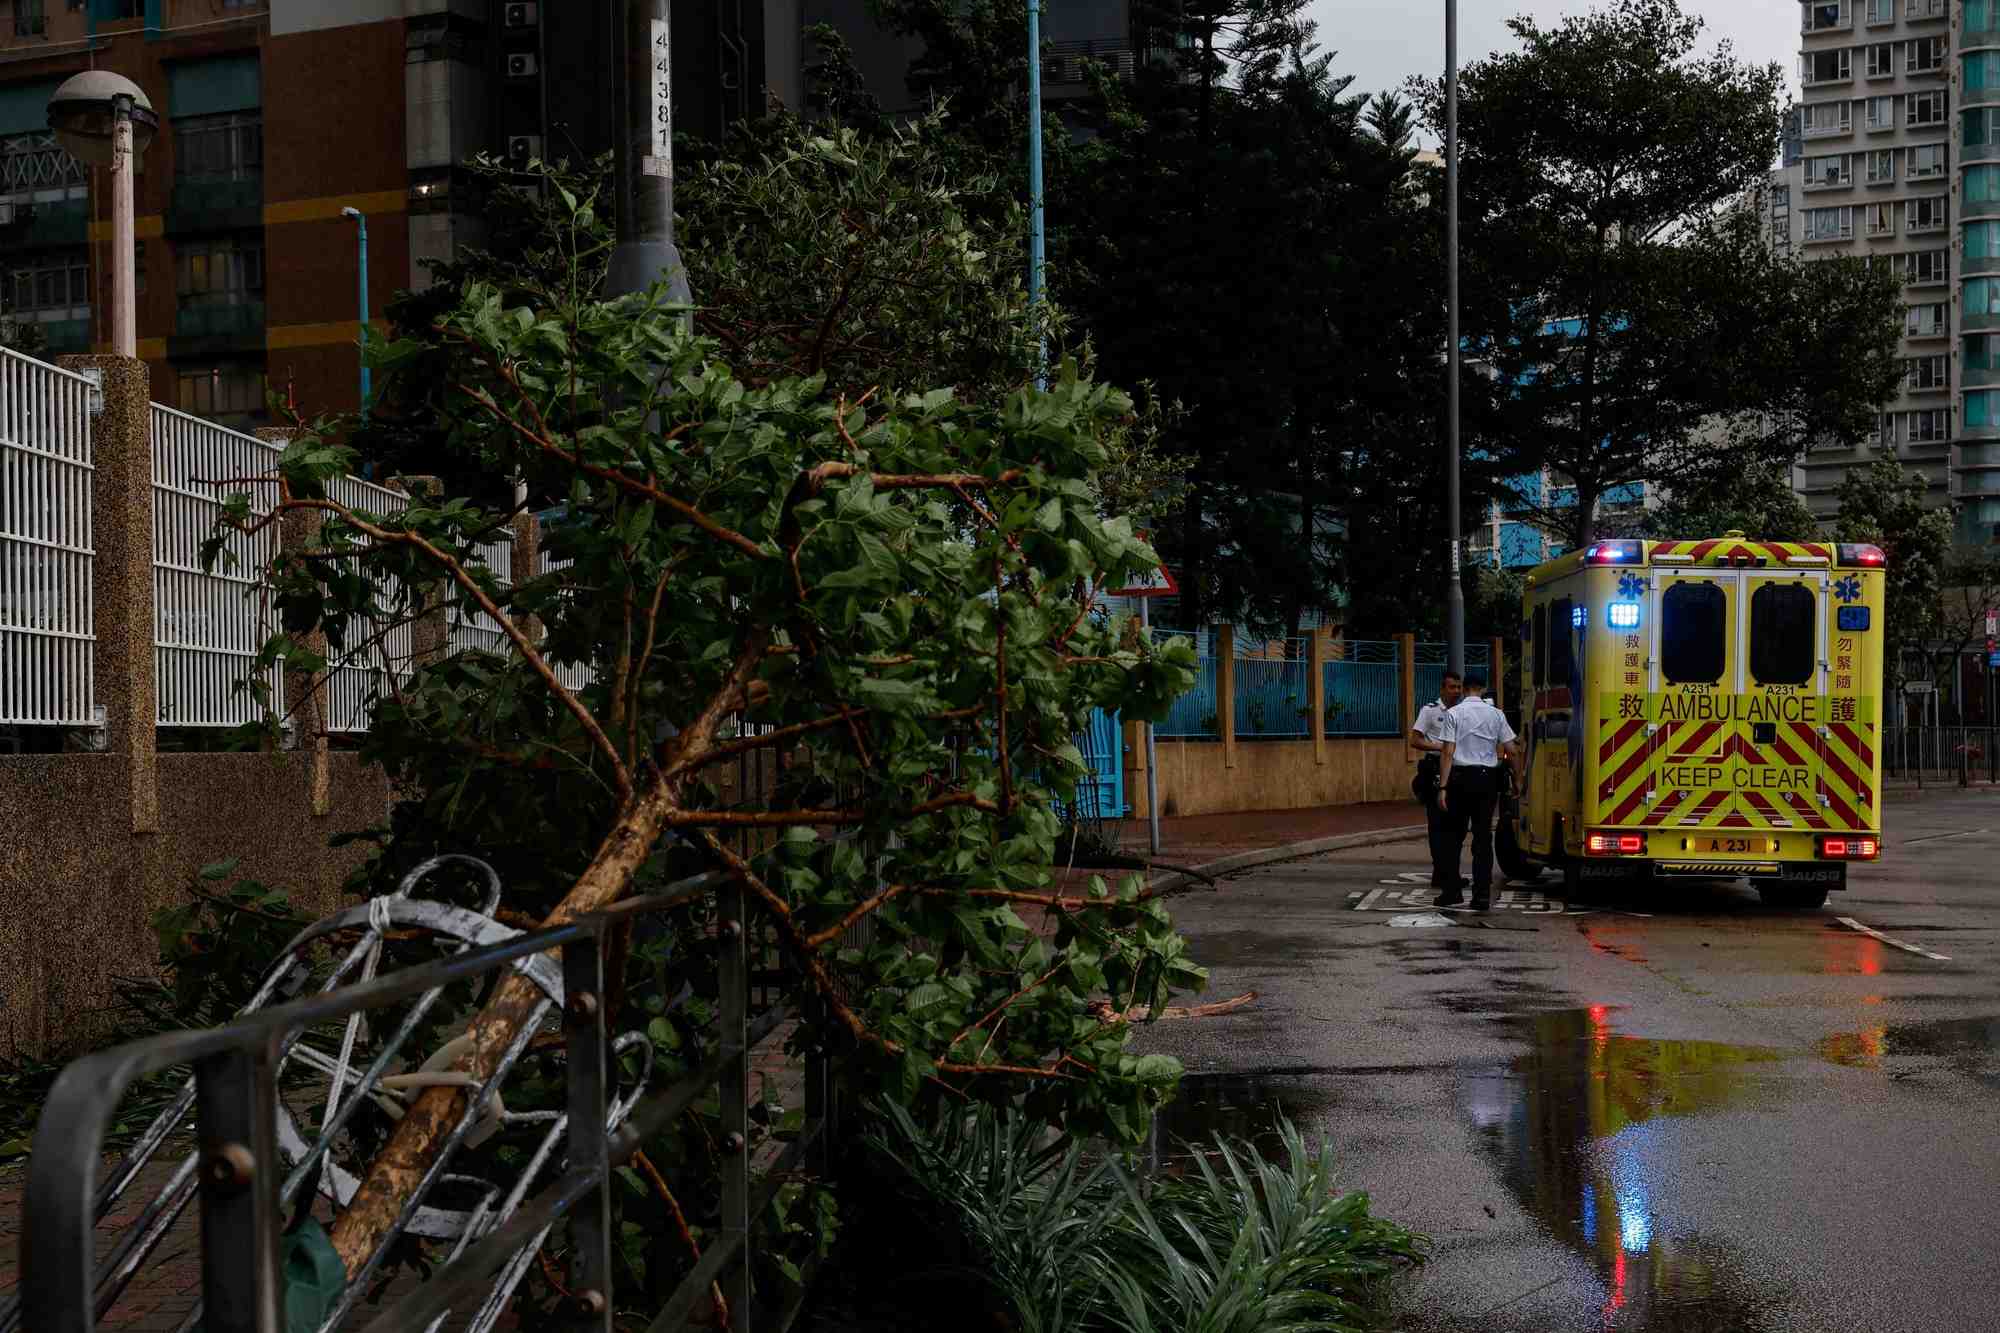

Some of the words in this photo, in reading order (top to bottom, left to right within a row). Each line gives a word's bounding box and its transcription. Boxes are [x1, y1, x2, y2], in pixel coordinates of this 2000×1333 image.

[655, 31, 669, 147] 44381
[1624, 633, 1640, 687] 救護車
[1681, 684, 1711, 695] A231
[1765, 685, 1795, 696] A231
[1619, 693, 1645, 719] 救
[1658, 694, 1816, 721] AMBULANCE
[1831, 696, 1856, 722] 護
[1661, 766, 1722, 787] KEEP
[1732, 767, 1809, 788] CLEAR
[1711, 839, 1719, 851] A
[1727, 839, 1751, 851] 231
